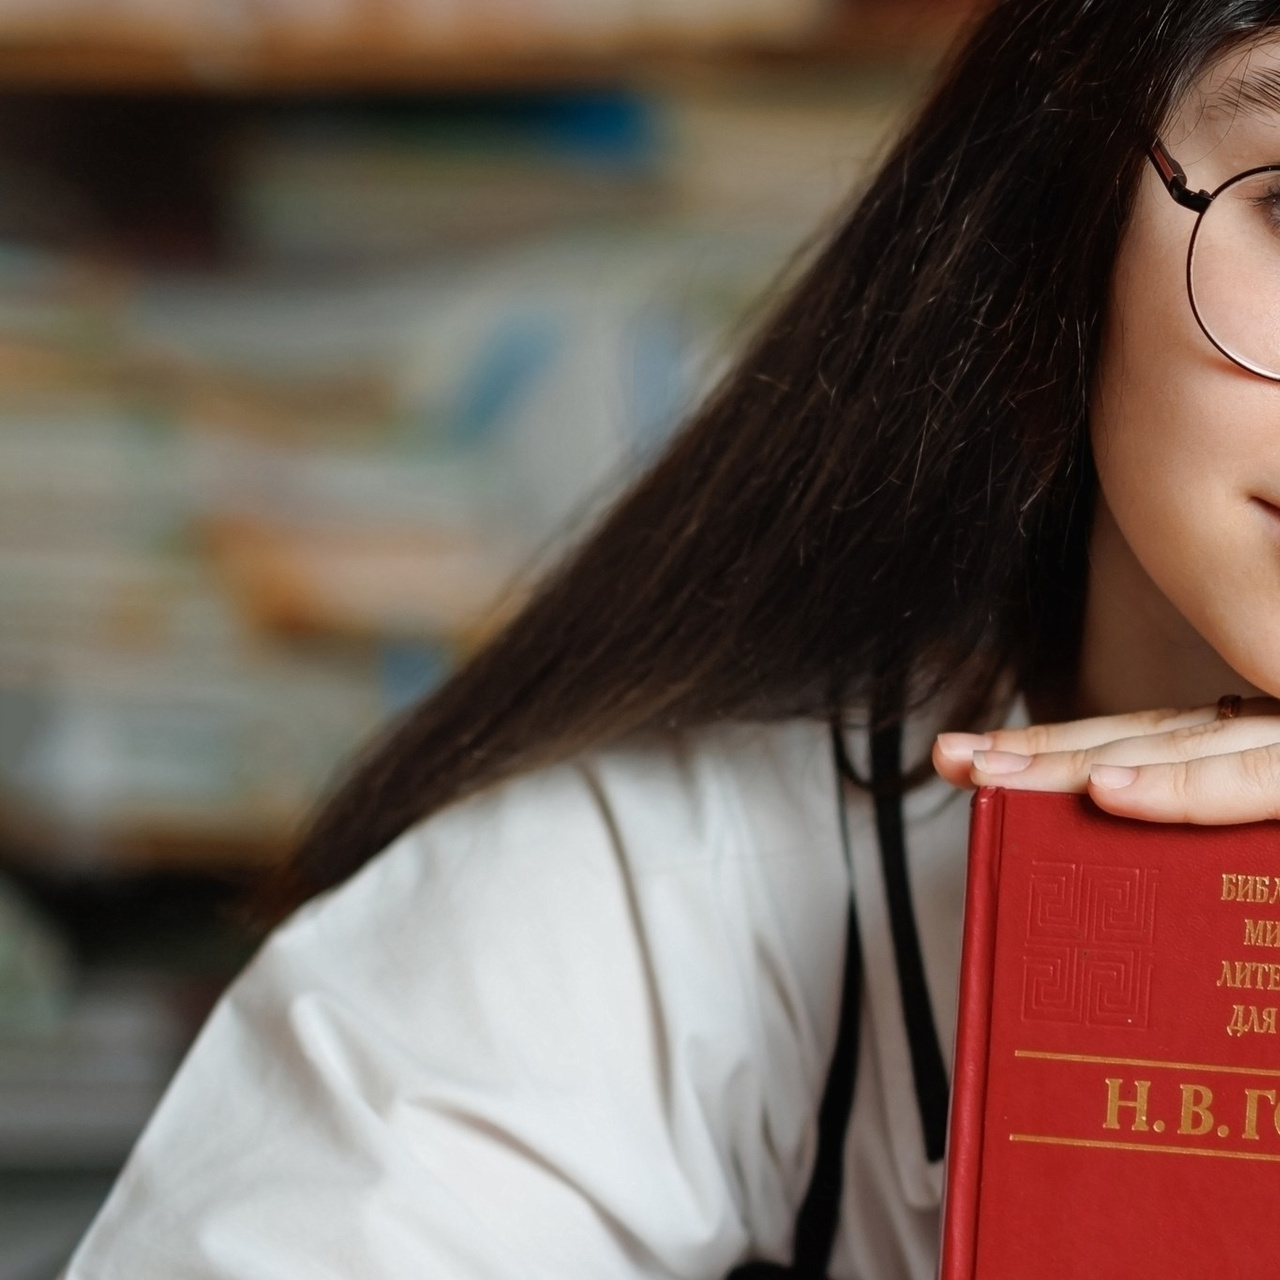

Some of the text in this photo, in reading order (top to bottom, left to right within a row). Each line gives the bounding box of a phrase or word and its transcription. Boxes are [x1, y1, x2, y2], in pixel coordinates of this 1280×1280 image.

[1226, 1004, 1278, 1037] ДЛЯ
[1102, 1077, 1165, 1133] Н.
[1177, 1083, 1230, 1139] В.
